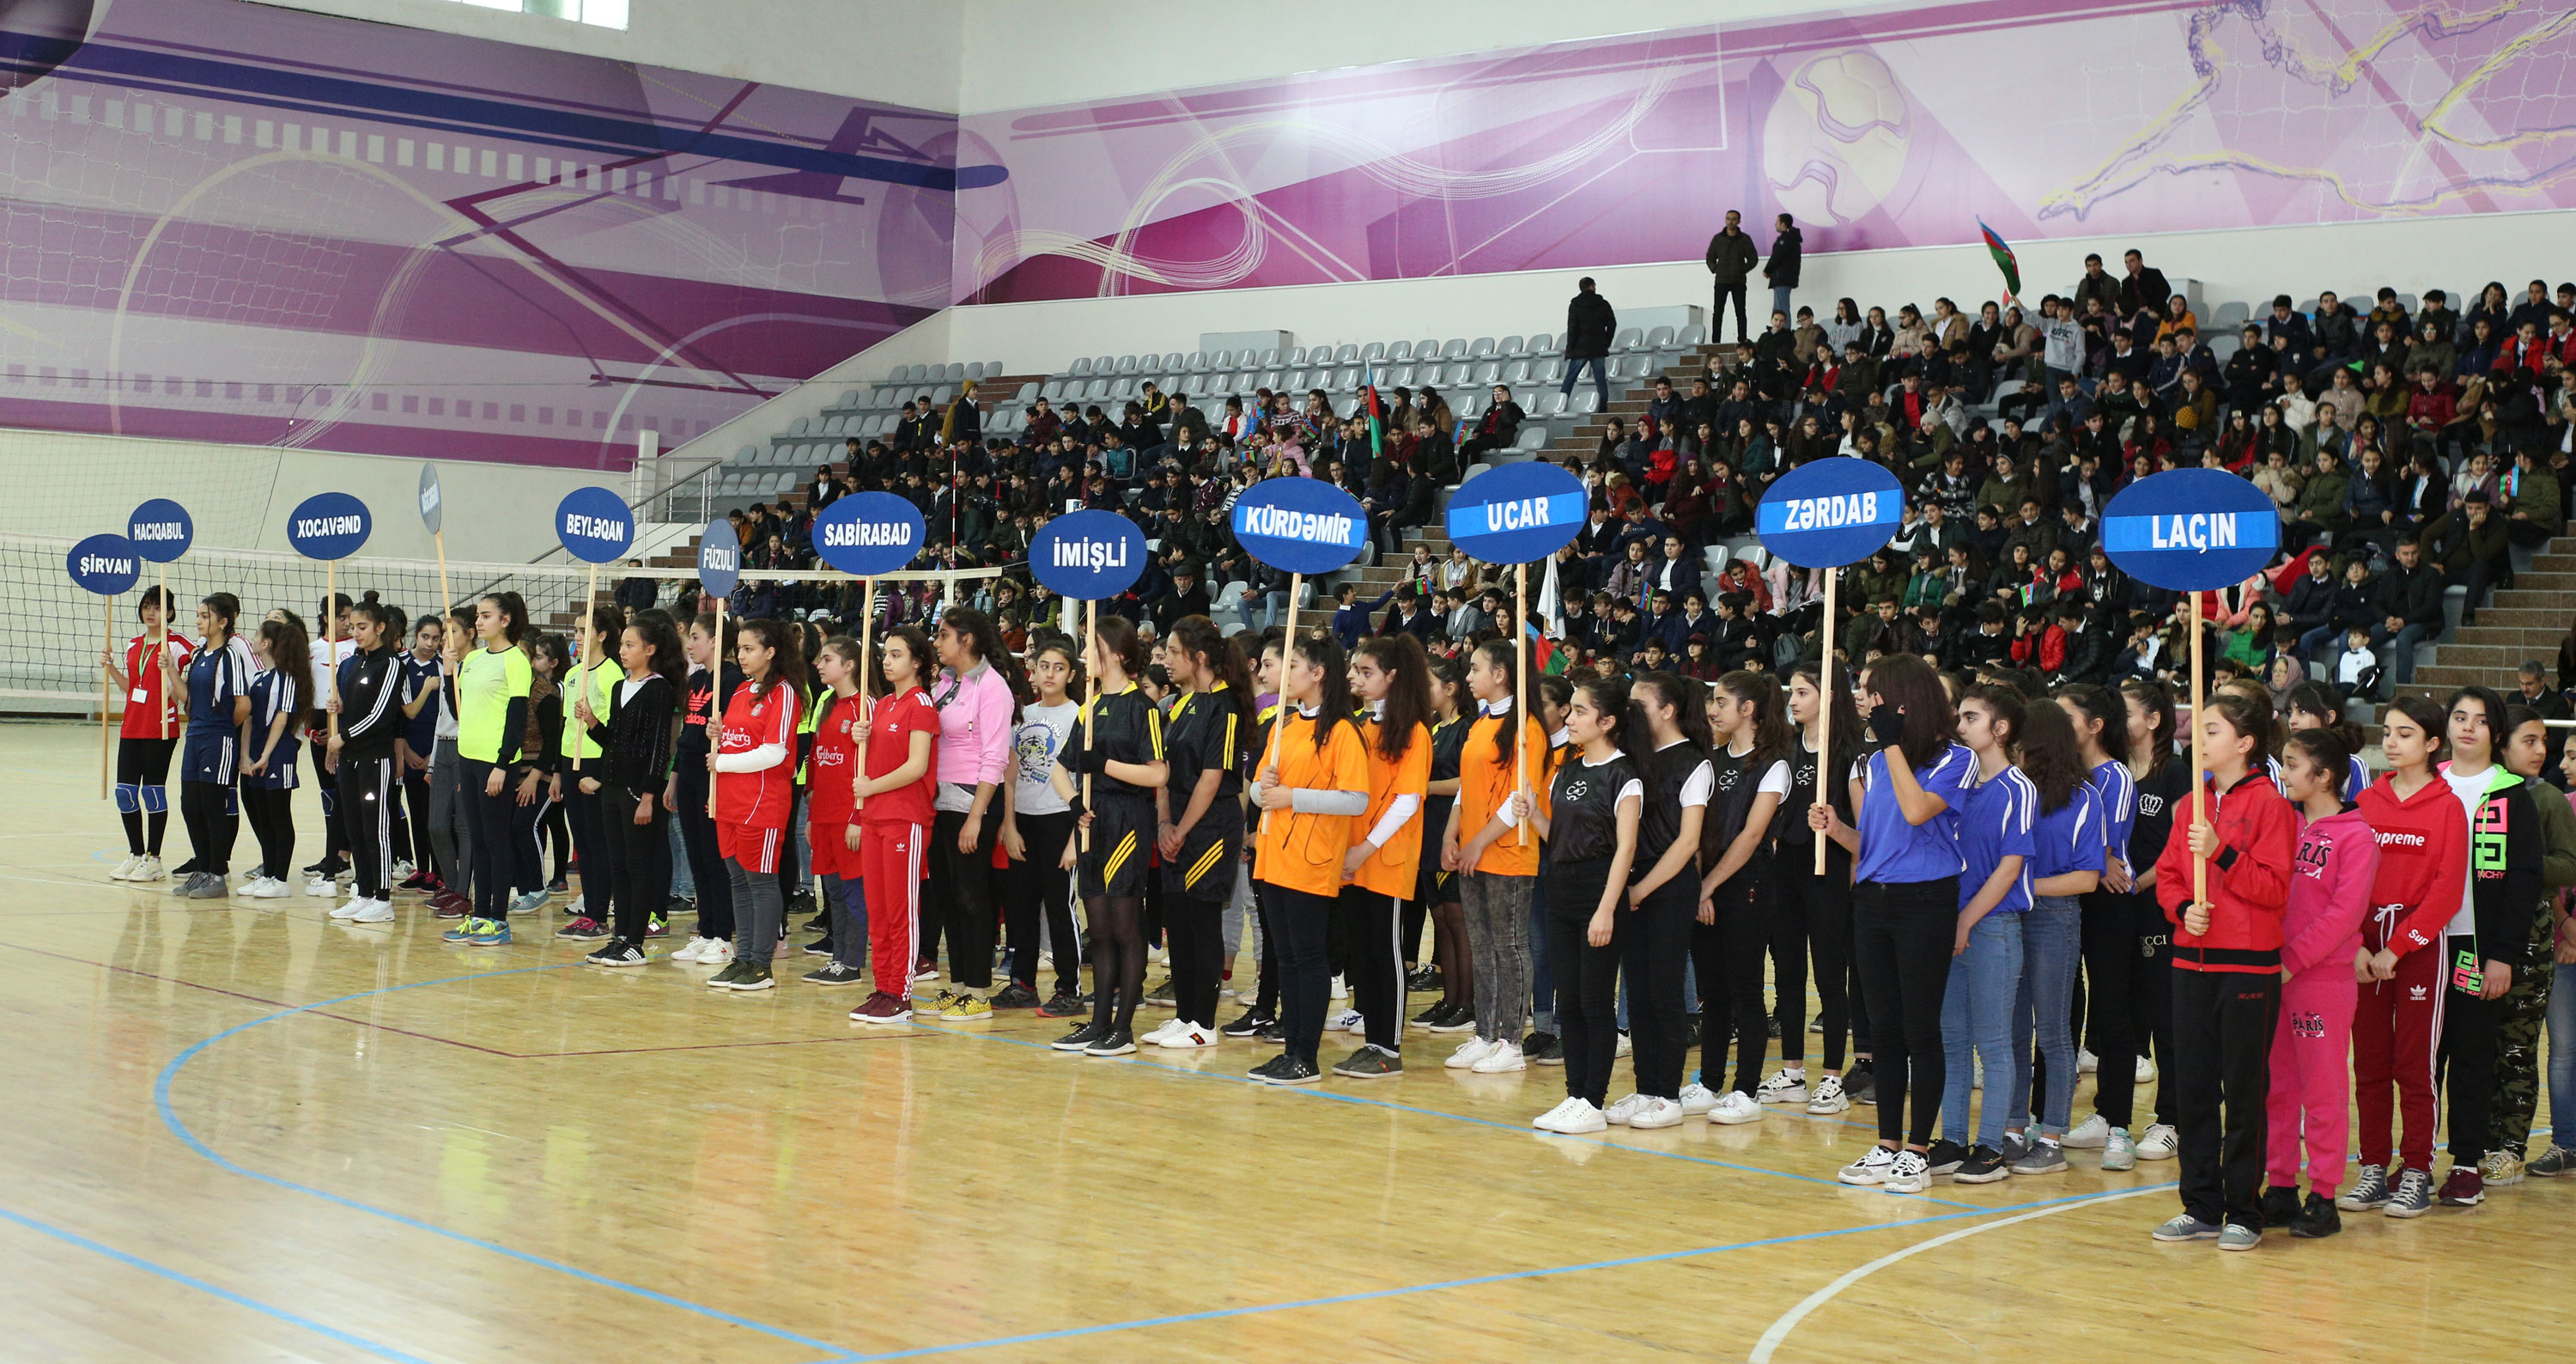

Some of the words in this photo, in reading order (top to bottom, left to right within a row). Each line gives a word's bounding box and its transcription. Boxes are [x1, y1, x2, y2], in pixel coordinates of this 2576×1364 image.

[1245, 503, 1352, 545] KÜRDƏMİR
[1487, 496, 1550, 532] UCAR
[1784, 491, 1877, 530] ZƏRDAB
[134, 522, 184, 541] HACIQABUL
[297, 515, 361, 539] XOCAVƏND
[566, 513, 624, 542] BEYLƏQAN
[824, 517, 911, 546] SABİRABAD
[2152, 513, 2236, 554] LAÇIN
[80, 553, 131, 576] ŞİRVAN
[702, 544, 735, 571] FÜZULİ
[1054, 536, 1127, 574] İMİŞLİ
[2295, 842, 2332, 868] RIS
